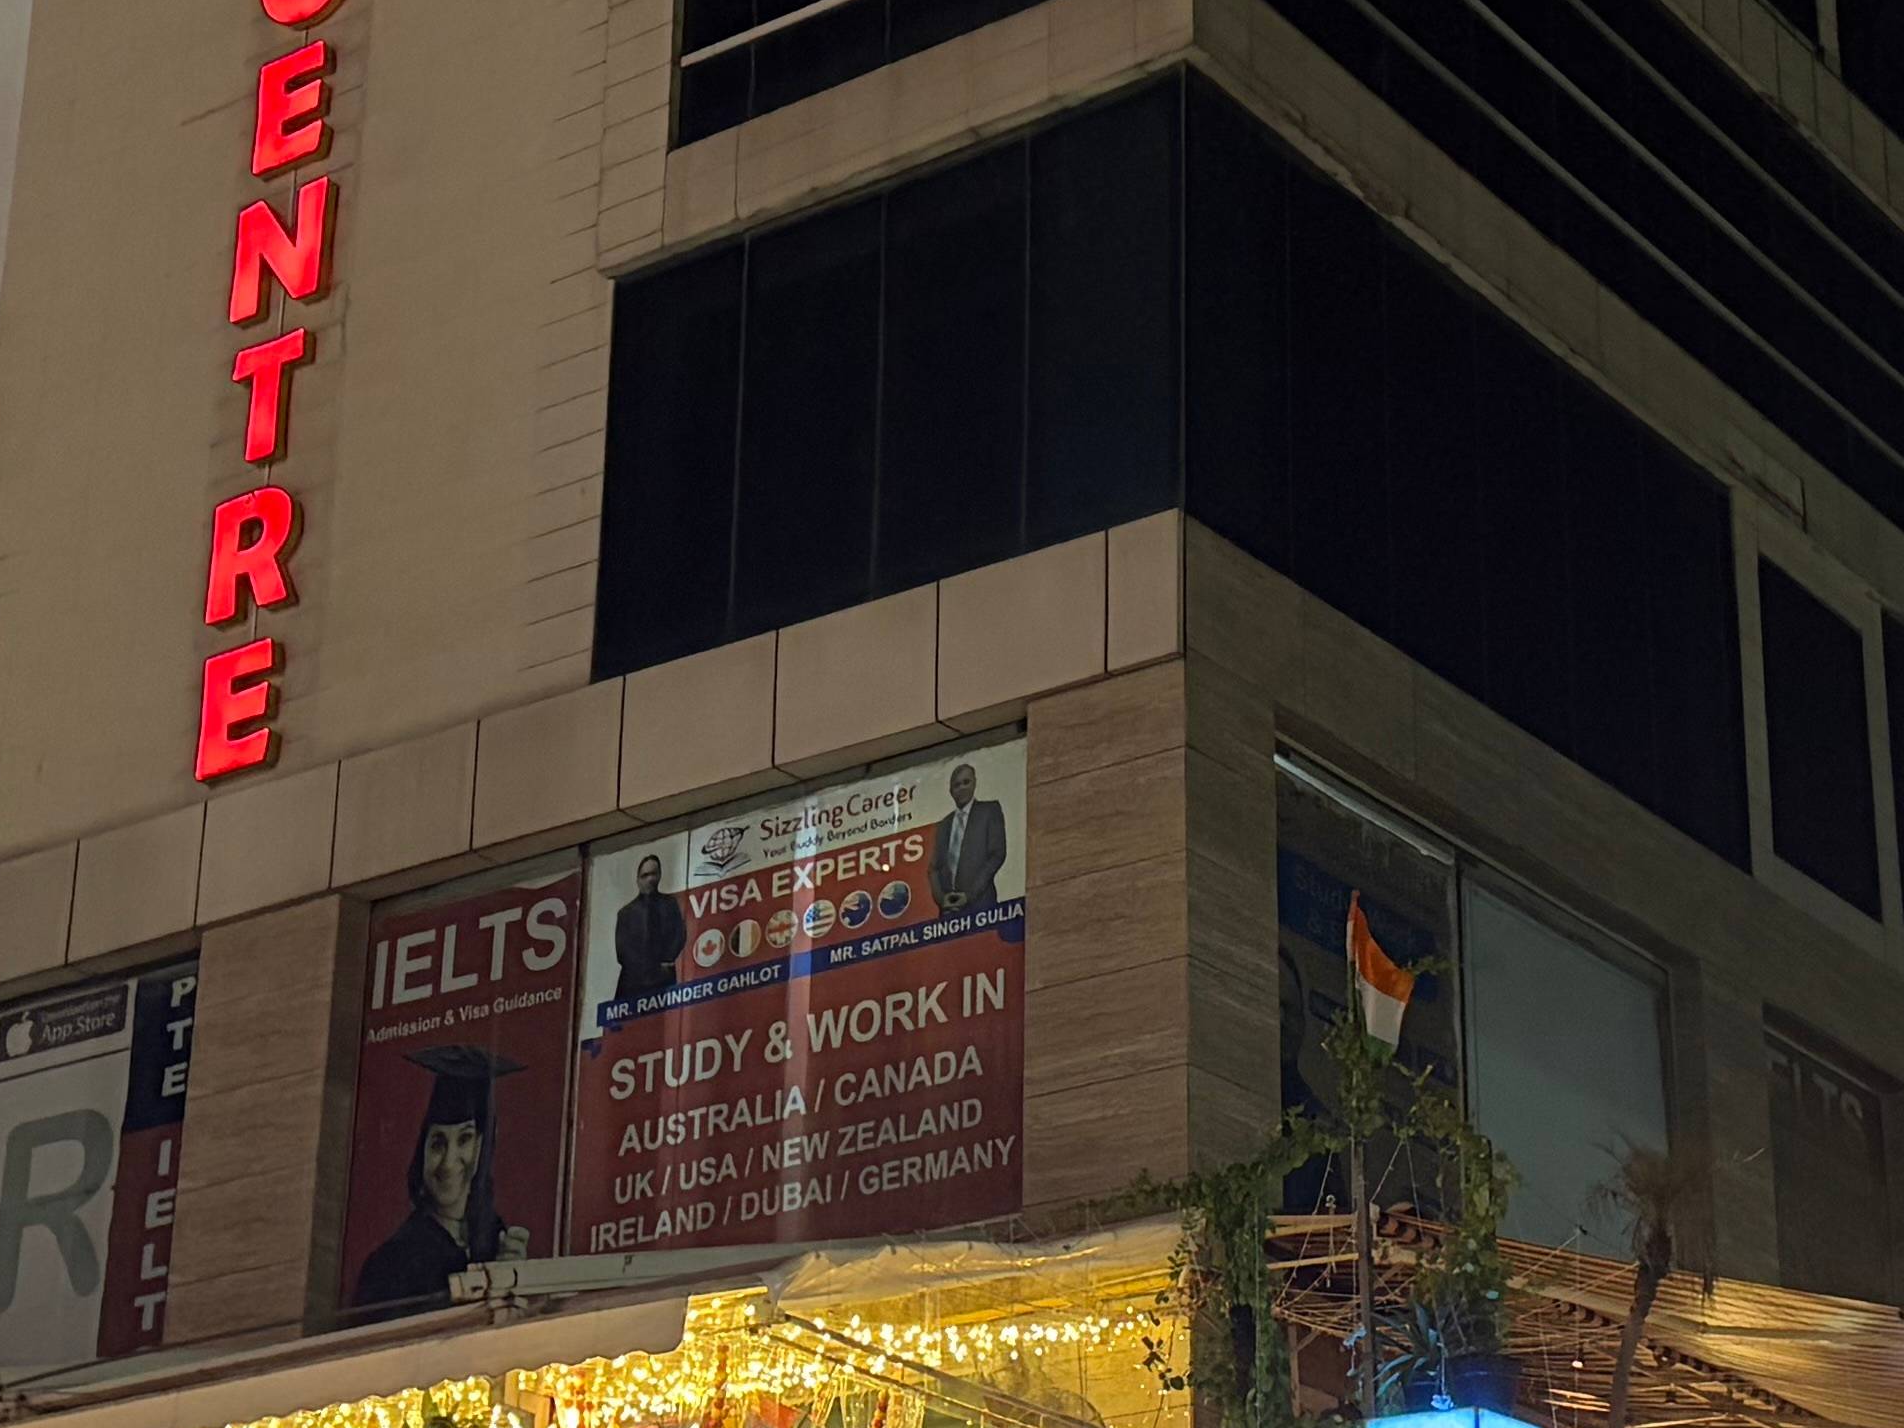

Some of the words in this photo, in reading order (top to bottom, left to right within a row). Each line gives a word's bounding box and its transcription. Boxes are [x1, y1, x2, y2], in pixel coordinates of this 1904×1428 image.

[760, 805, 843, 841] Sizzling
[847, 785, 916, 816] Career
[688, 878, 764, 921] VISA
[771, 834, 924, 898] EXPERTS
[370, 898, 569, 1011] IELTS
[830, 947, 857, 964] MR.
[861, 930, 918, 957] SATPAL
[922, 916, 971, 941] SINGH
[974, 903, 1025, 929] GULIA
[40, 1023, 72, 1044] App
[76, 1013, 115, 1032] Store
[367, 1015, 441, 1044] Admission
[444, 1010, 455, 1027] &
[459, 1004, 489, 1022] Visa
[493, 987, 562, 1014] Guidance
[606, 1004, 633, 1021] MR.
[637, 981, 713, 1013] RAVINDER
[717, 964, 781, 992] GAHLOT
[610, 1029, 752, 1102] STUDY
[763, 1021, 793, 1062] &
[806, 982, 949, 1052] WORK
[962, 969, 1005, 1018] IN
[618, 1084, 807, 1156] AUSTRALIA
[833, 1045, 984, 1108] CANADA
[590, 1200, 715, 1253] IRELAND
[740, 1177, 833, 1221] DUBAI
[857, 1136, 1016, 1196] GERMANY
[613, 1167, 655, 1205] UK
[678, 1148, 738, 1189] USA
[762, 1129, 830, 1170] NEW
[837, 1098, 982, 1154] ZEALAND
